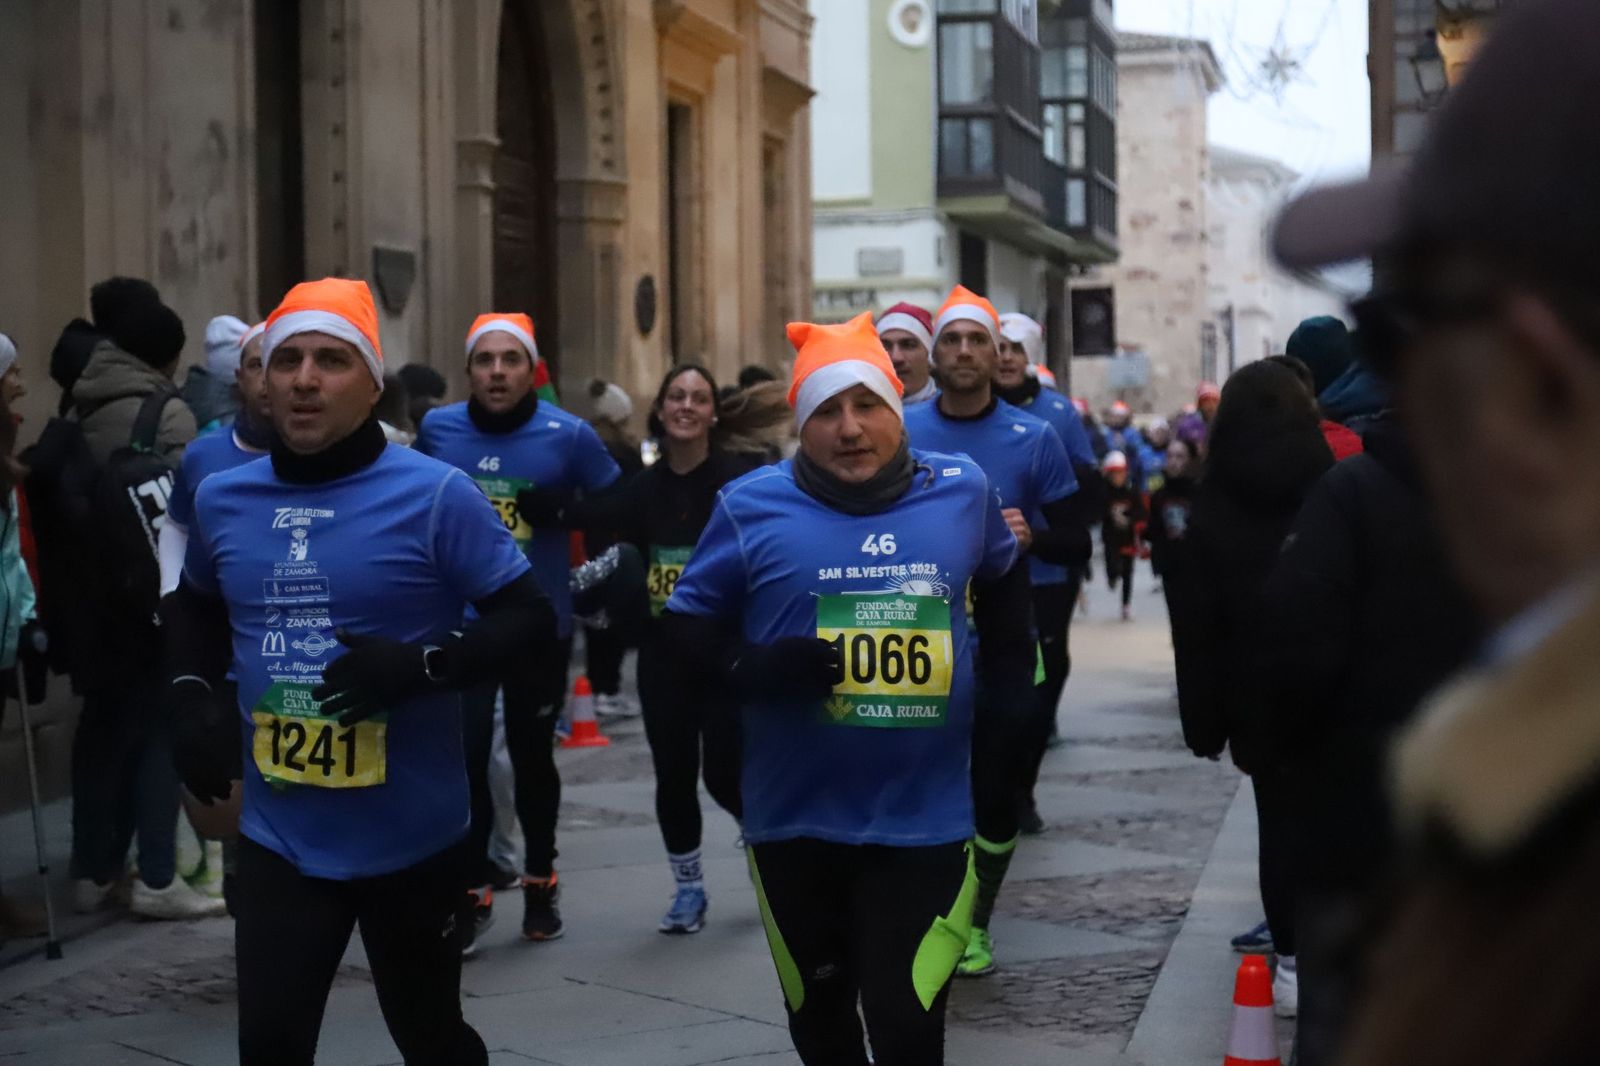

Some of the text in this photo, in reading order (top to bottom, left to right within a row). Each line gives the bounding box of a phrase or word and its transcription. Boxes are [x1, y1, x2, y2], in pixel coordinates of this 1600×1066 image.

[478, 456, 501, 471] 46
[861, 533, 897, 556] 46
[284, 567, 317, 577] ZAMORA
[818, 562, 938, 580] SAN SILVESTRE 2025
[284, 585, 300, 594] CAJA
[855, 610, 917, 621] CAJA RURAL
[286, 618, 332, 628] ZAMORA
[834, 633, 931, 685] 1066
[284, 661, 328, 674] Miguel
[283, 689, 314, 700] FUND
[856, 704, 940, 718] CAJA RURAL
[269, 718, 356, 778] 1241
